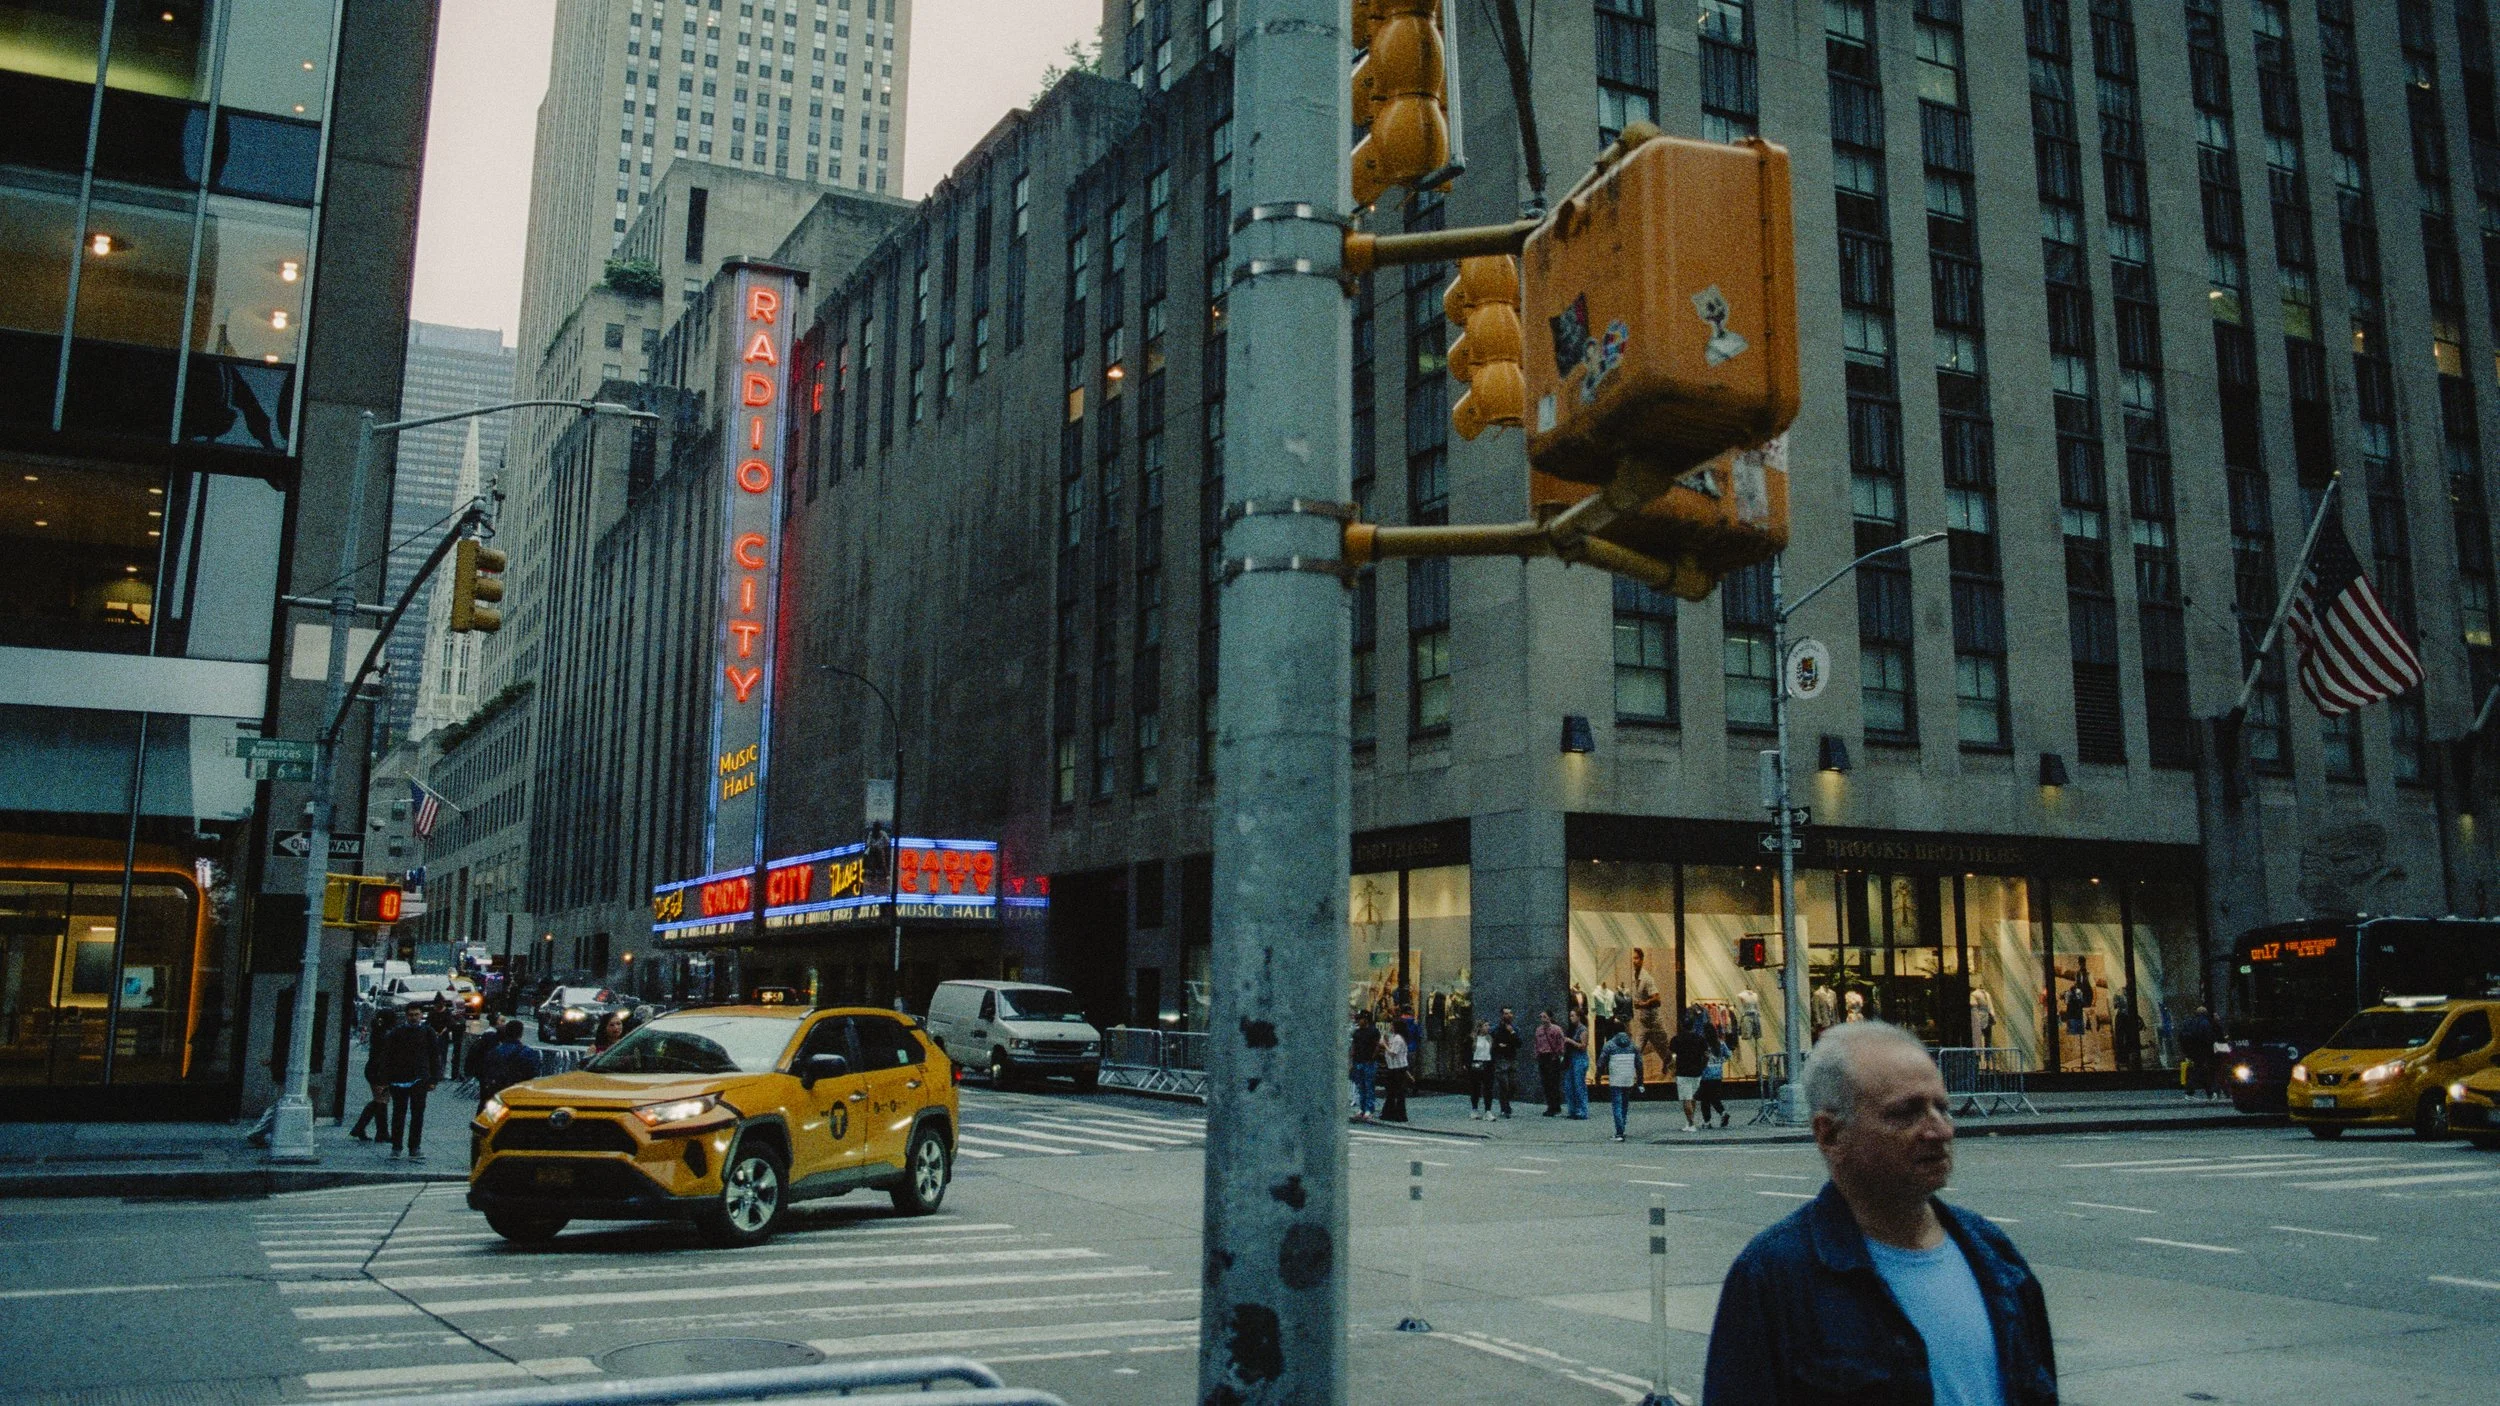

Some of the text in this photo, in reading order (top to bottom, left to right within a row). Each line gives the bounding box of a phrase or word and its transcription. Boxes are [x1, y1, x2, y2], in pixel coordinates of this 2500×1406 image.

[736, 285, 781, 494] RADIO
[725, 532, 767, 703] CITY
[250, 746, 301, 759] Americas
[719, 743, 758, 777] MUSIC
[277, 763, 285, 778] 6
[722, 771, 756, 801] HALL
[290, 838, 311, 851] ON
[1825, 838, 1906, 860] BROOKS
[1914, 842, 2025, 864] BROTHERS
[901, 850, 994, 874] RADIO
[702, 877, 750, 917] RADIO
[766, 864, 813, 906] CITY
[901, 871, 992, 895] CITY
[896, 904, 995, 919] MUSIC HALL
